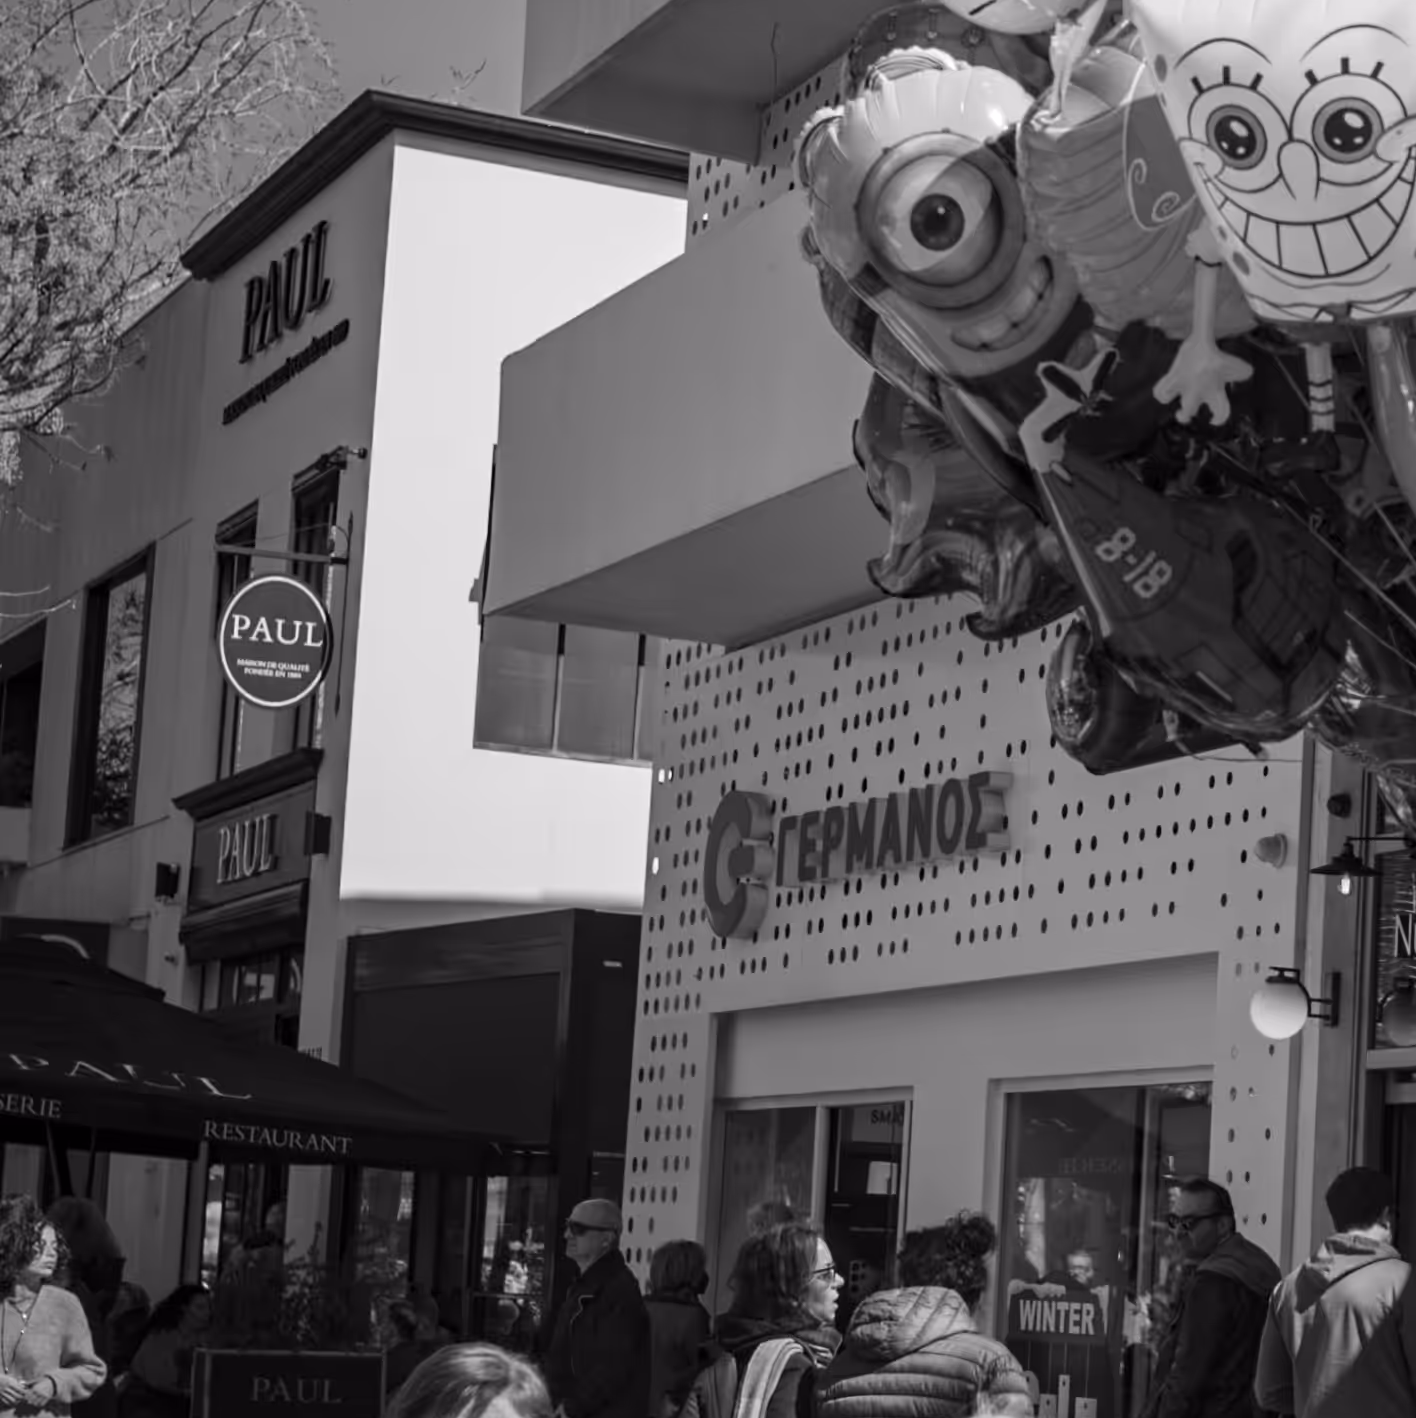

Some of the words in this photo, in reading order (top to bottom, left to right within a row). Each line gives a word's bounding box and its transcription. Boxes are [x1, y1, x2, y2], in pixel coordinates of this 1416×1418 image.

[238, 220, 332, 364] PAUL
[1095, 526, 1173, 598] 8-18
[230, 613, 324, 648] PAUL
[216, 813, 273, 885] PAUL
[776, 771, 1005, 887] ΓΕΡΜΑΝΟΣ
[8, 1053, 253, 1100] PAUL
[203, 1119, 354, 1156] RESTAURANT
[1018, 1298, 1095, 1336] WINTER
[249, 1375, 343, 1405] PAUL
